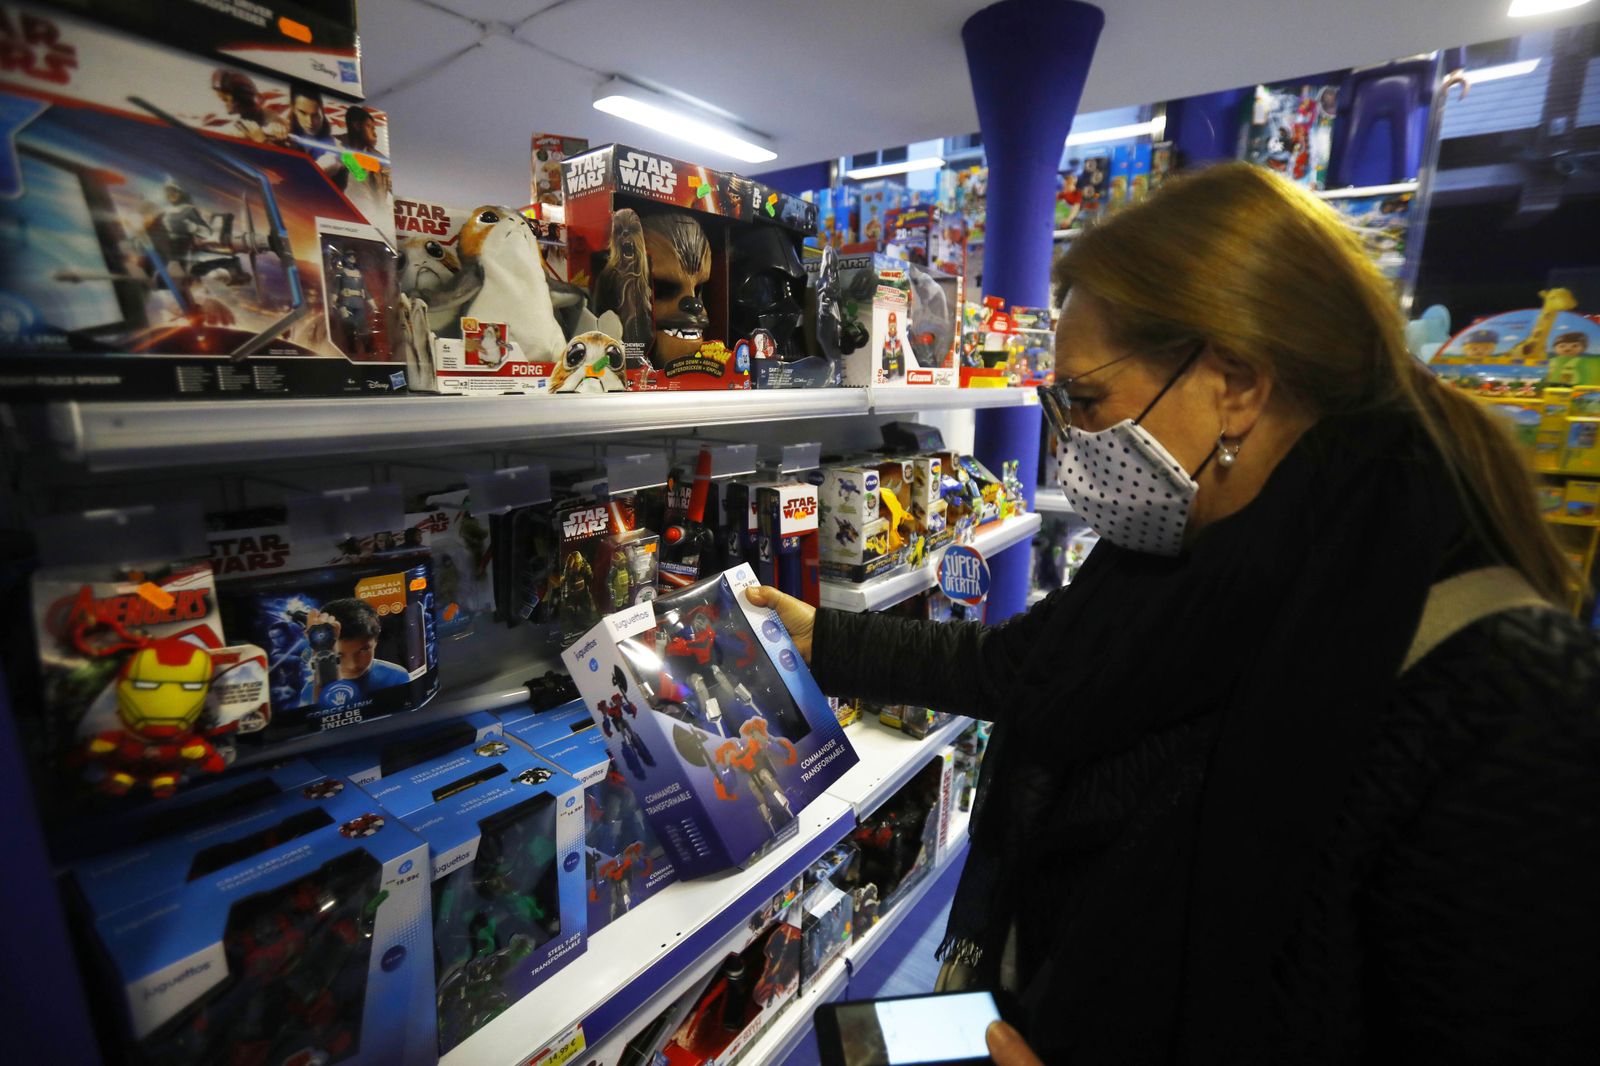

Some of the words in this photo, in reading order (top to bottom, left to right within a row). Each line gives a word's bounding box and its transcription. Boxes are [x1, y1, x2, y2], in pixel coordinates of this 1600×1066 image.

[567, 156, 605, 178] STAR
[620, 152, 677, 179] STAR
[567, 168, 605, 195] WARS
[620, 167, 677, 194] WARS
[632, 188, 650, 196] FORCE
[652, 192, 676, 201] AWAKENS
[394, 200, 450, 222] STAR
[394, 215, 451, 236] WARS
[839, 257, 870, 269] ART
[512, 365, 543, 375] PORG
[366, 379, 389, 390] Disney
[783, 497, 816, 510] STAR
[563, 507, 608, 527] STAR
[563, 518, 608, 538] WARS
[945, 551, 980, 580] SÚPER
[945, 576, 982, 596] OFERTTA
[612, 611, 650, 631] juguettos
[573, 639, 597, 661] juguettos
[346, 699, 373, 709] LINK
[320, 715, 363, 731] INICIO
[321, 713, 342, 724] KIT
[345, 709, 361, 719] DE
[800, 739, 837, 769] COMMANDER
[800, 744, 846, 782] TRANSFORMABLE
[410, 770, 431, 781] STEEL
[413, 759, 472, 785] TRANSFORMABLE
[456, 788, 516, 815] TRANSFORMABLE
[645, 782, 681, 803] COMMANDER
[645, 790, 692, 815] TRANSFORMABLE
[434, 851, 471, 876] juguettos
[649, 864, 673, 880] COMMAN
[645, 868, 675, 889] TRANSFORM
[547, 943, 564, 957] STEEL
[565, 931, 581, 945] T-REX
[531, 938, 581, 976] TRANSFORMABLE
[144, 960, 213, 1000] juguettos
